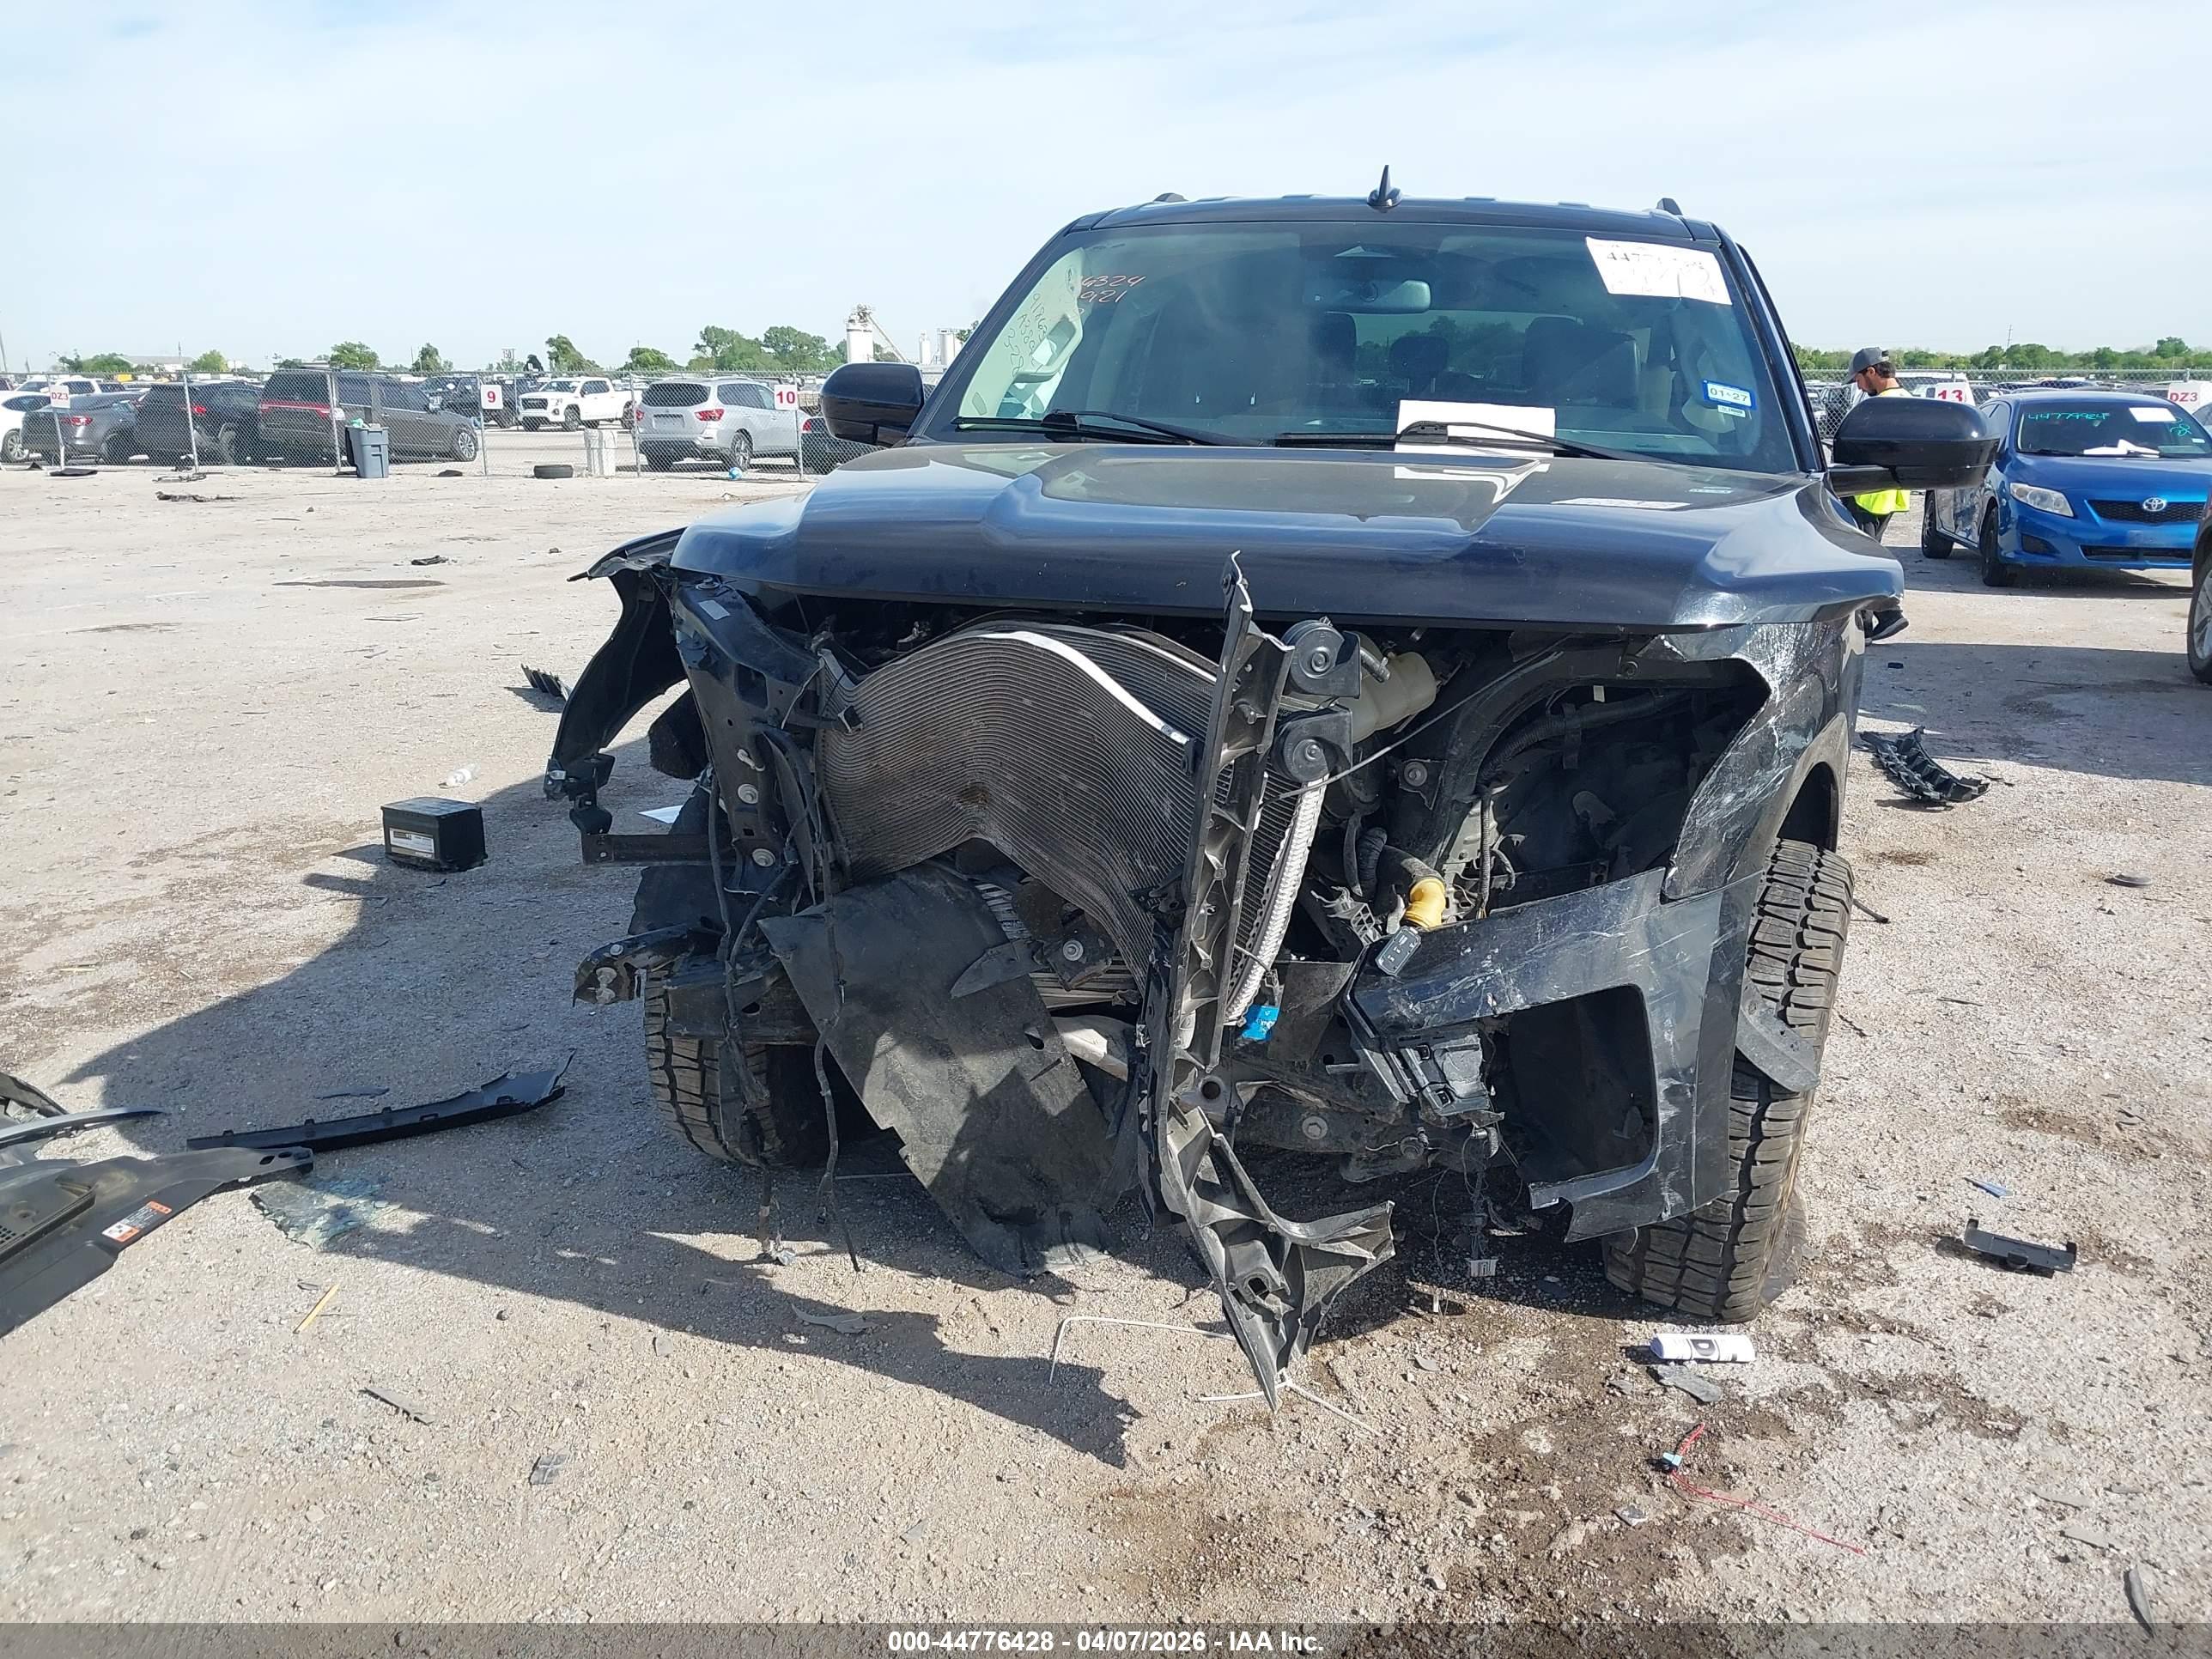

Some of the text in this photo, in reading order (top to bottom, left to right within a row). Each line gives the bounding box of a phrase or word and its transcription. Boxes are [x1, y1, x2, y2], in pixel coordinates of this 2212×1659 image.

[52, 392, 69, 400] DZ3
[487, 391, 496, 403] 9
[776, 391, 795, 404] 10
[1938, 389, 1963, 402] 13
[2170, 392, 2198, 402] DZ3
